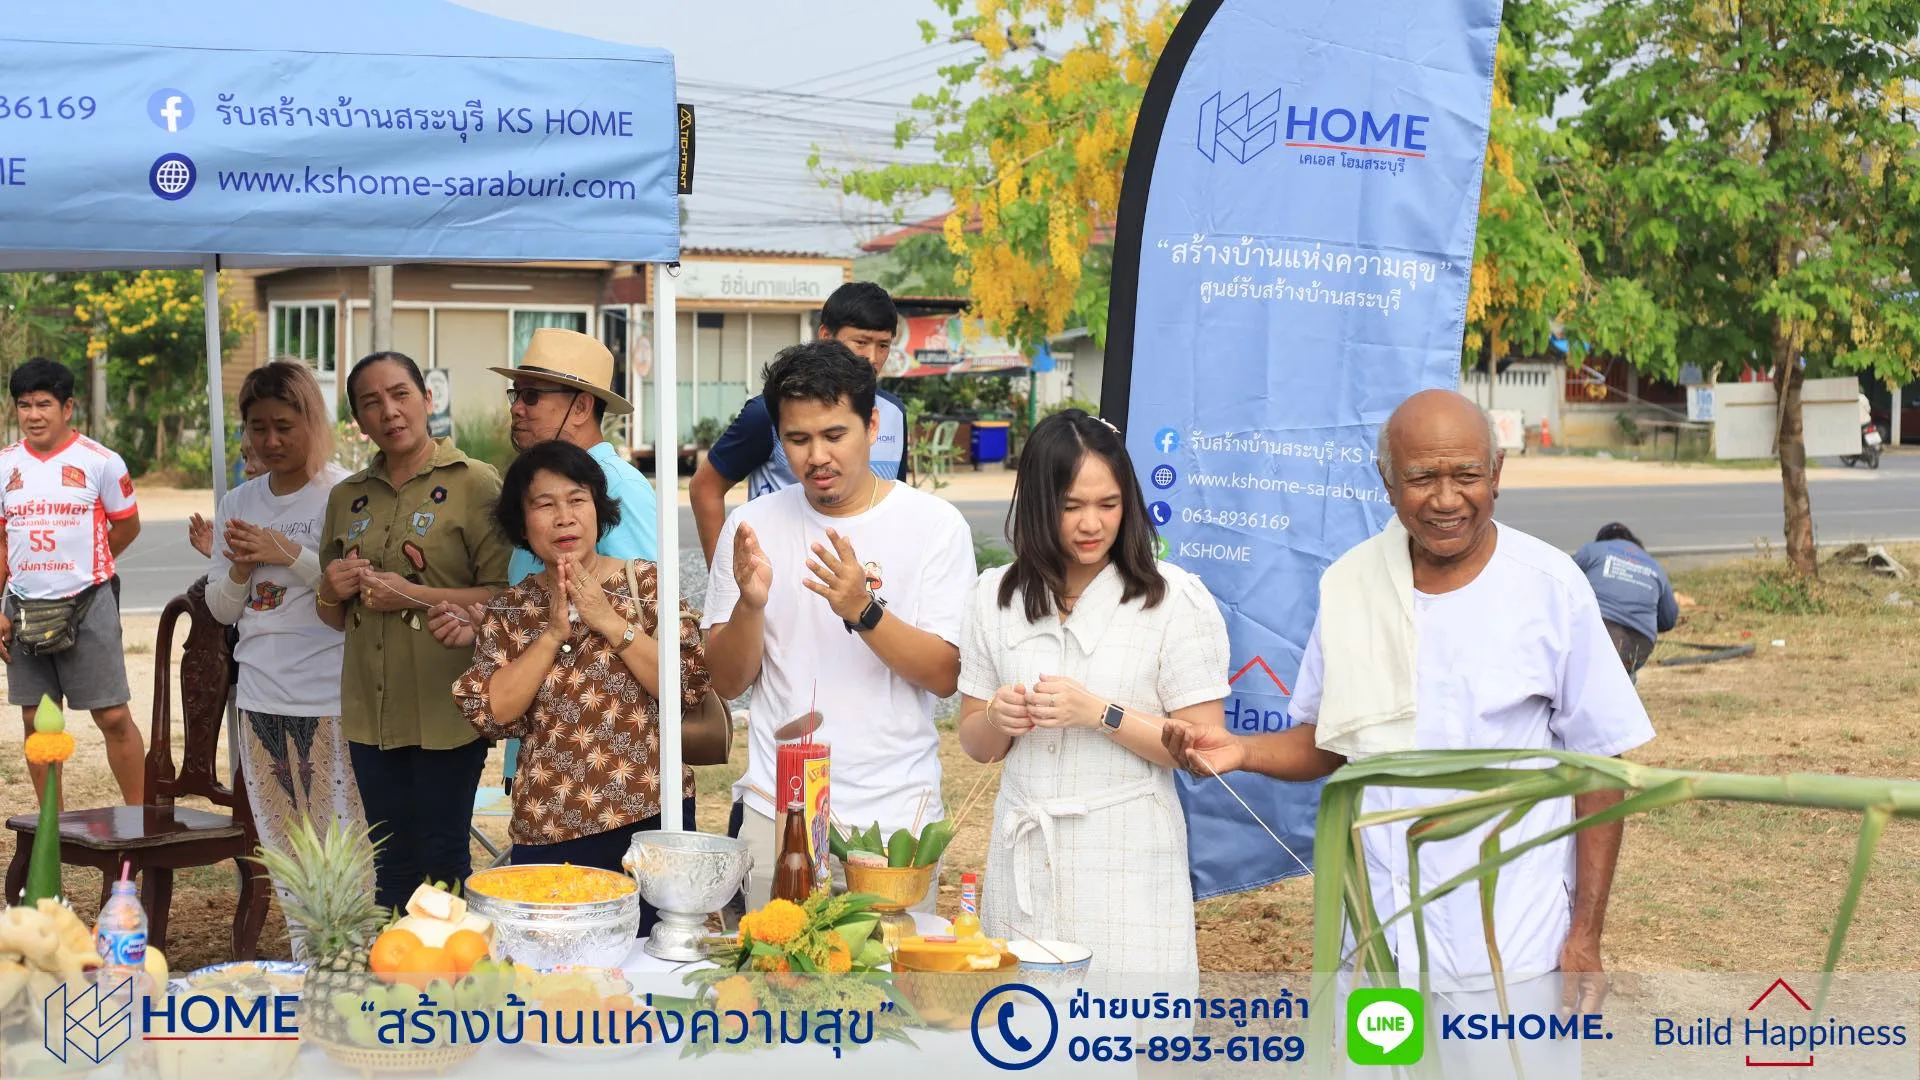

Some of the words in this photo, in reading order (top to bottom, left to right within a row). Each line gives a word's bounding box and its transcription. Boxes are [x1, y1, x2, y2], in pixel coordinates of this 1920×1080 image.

[216, 93, 484, 144] รับสร้างบ้านสระบุรี
[498, 107, 533, 134] KS
[546, 109, 633, 137] HOME
[1285, 105, 1430, 151] HOME
[1299, 152, 1335, 167] เคเอส
[1341, 152, 1406, 177] โฮมสระบุรี
[218, 165, 636, 200] www.kshome-saraburi.com
[1199, 275, 1402, 317] ศูนย์รับสร้างบ้านสระบุรี
[1190, 430, 1335, 465] รับสร้างบ้านสระบุรี
[1340, 447, 1362, 463] KS
[1187, 471, 1390, 504] www.kshome-saraburi.c
[1182, 508, 1290, 531] 063-8936169
[29, 530, 56, 553] 55
[1179, 541, 1251, 562] KSHOME
